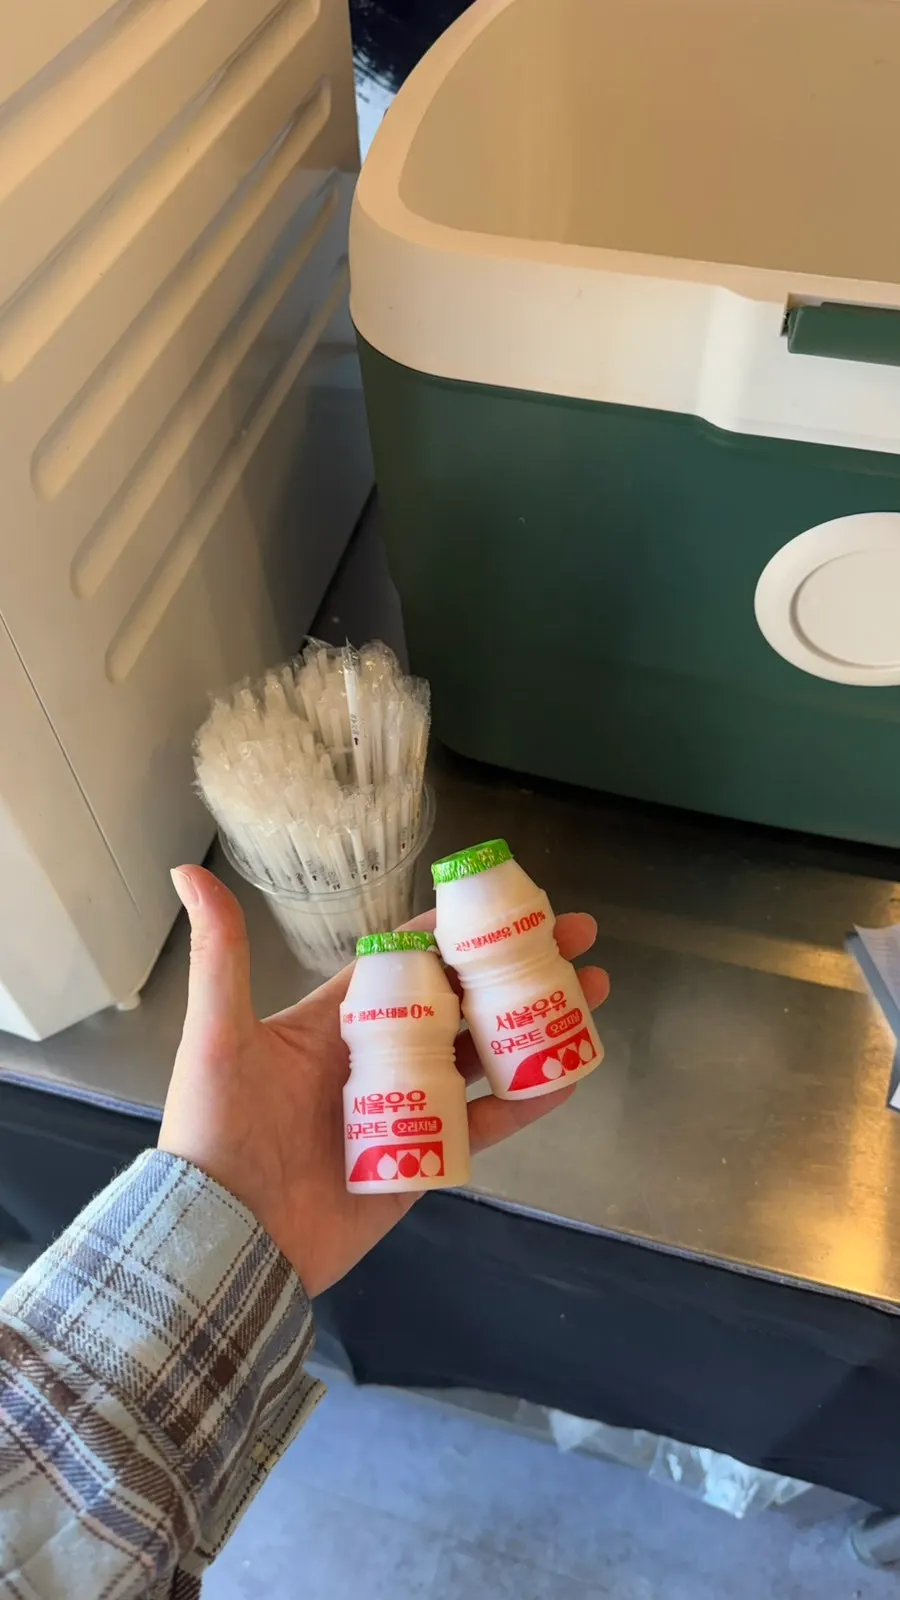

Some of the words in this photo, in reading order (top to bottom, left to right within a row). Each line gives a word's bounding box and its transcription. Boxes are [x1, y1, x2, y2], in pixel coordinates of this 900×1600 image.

[471, 926, 512, 949] 탈지분유
[512, 910, 546, 935] 100%
[410, 1004, 435, 1019] 0%
[496, 990, 567, 1032] 서울우유
[490, 1029, 545, 1055] 요구르트
[550, 1009, 580, 1034] 오리지널
[352, 1090, 427, 1116] 서울우유
[346, 1121, 389, 1140] 요구르트
[397, 1120, 438, 1134] 오리지널
